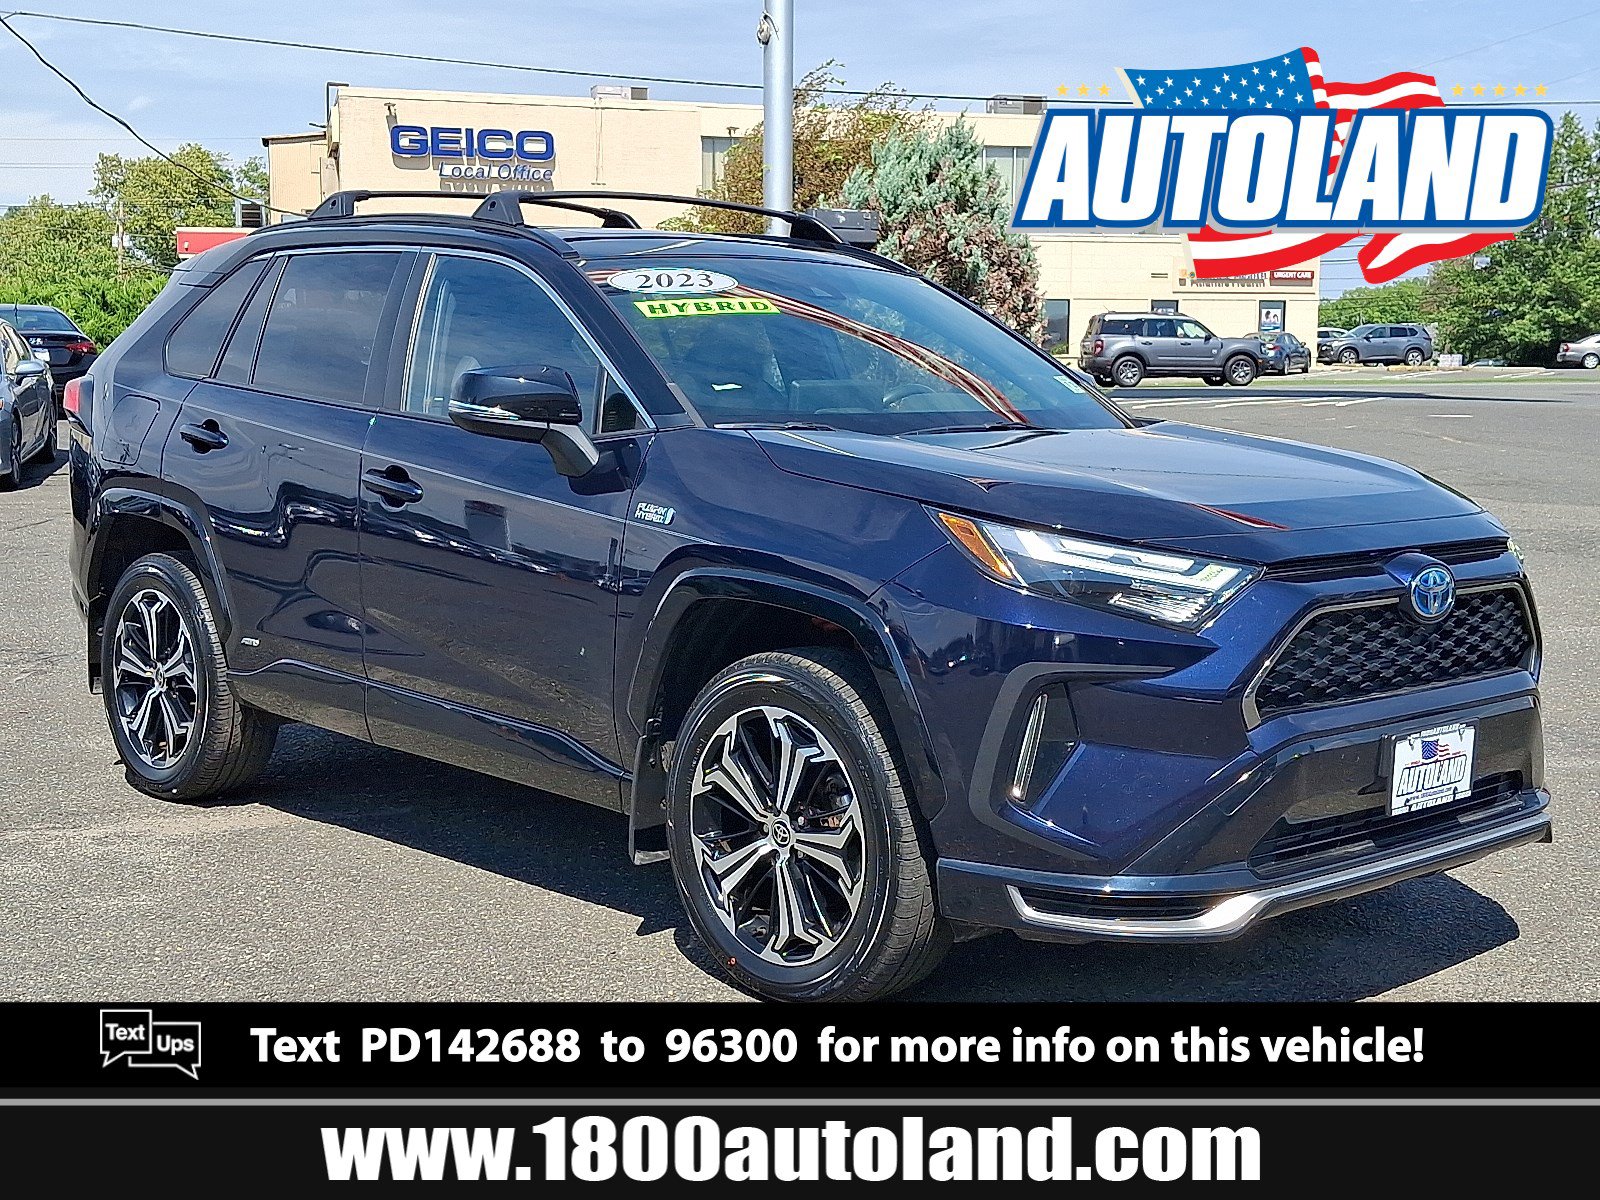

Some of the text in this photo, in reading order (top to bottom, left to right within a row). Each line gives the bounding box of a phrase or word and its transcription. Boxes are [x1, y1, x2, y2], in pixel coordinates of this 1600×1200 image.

[390, 125, 554, 160] GEICO
[439, 162, 553, 180] Local Office
[634, 273, 714, 289] 2023
[647, 301, 770, 315] HYBRID
[1396, 754, 1467, 797] AUTOLAND
